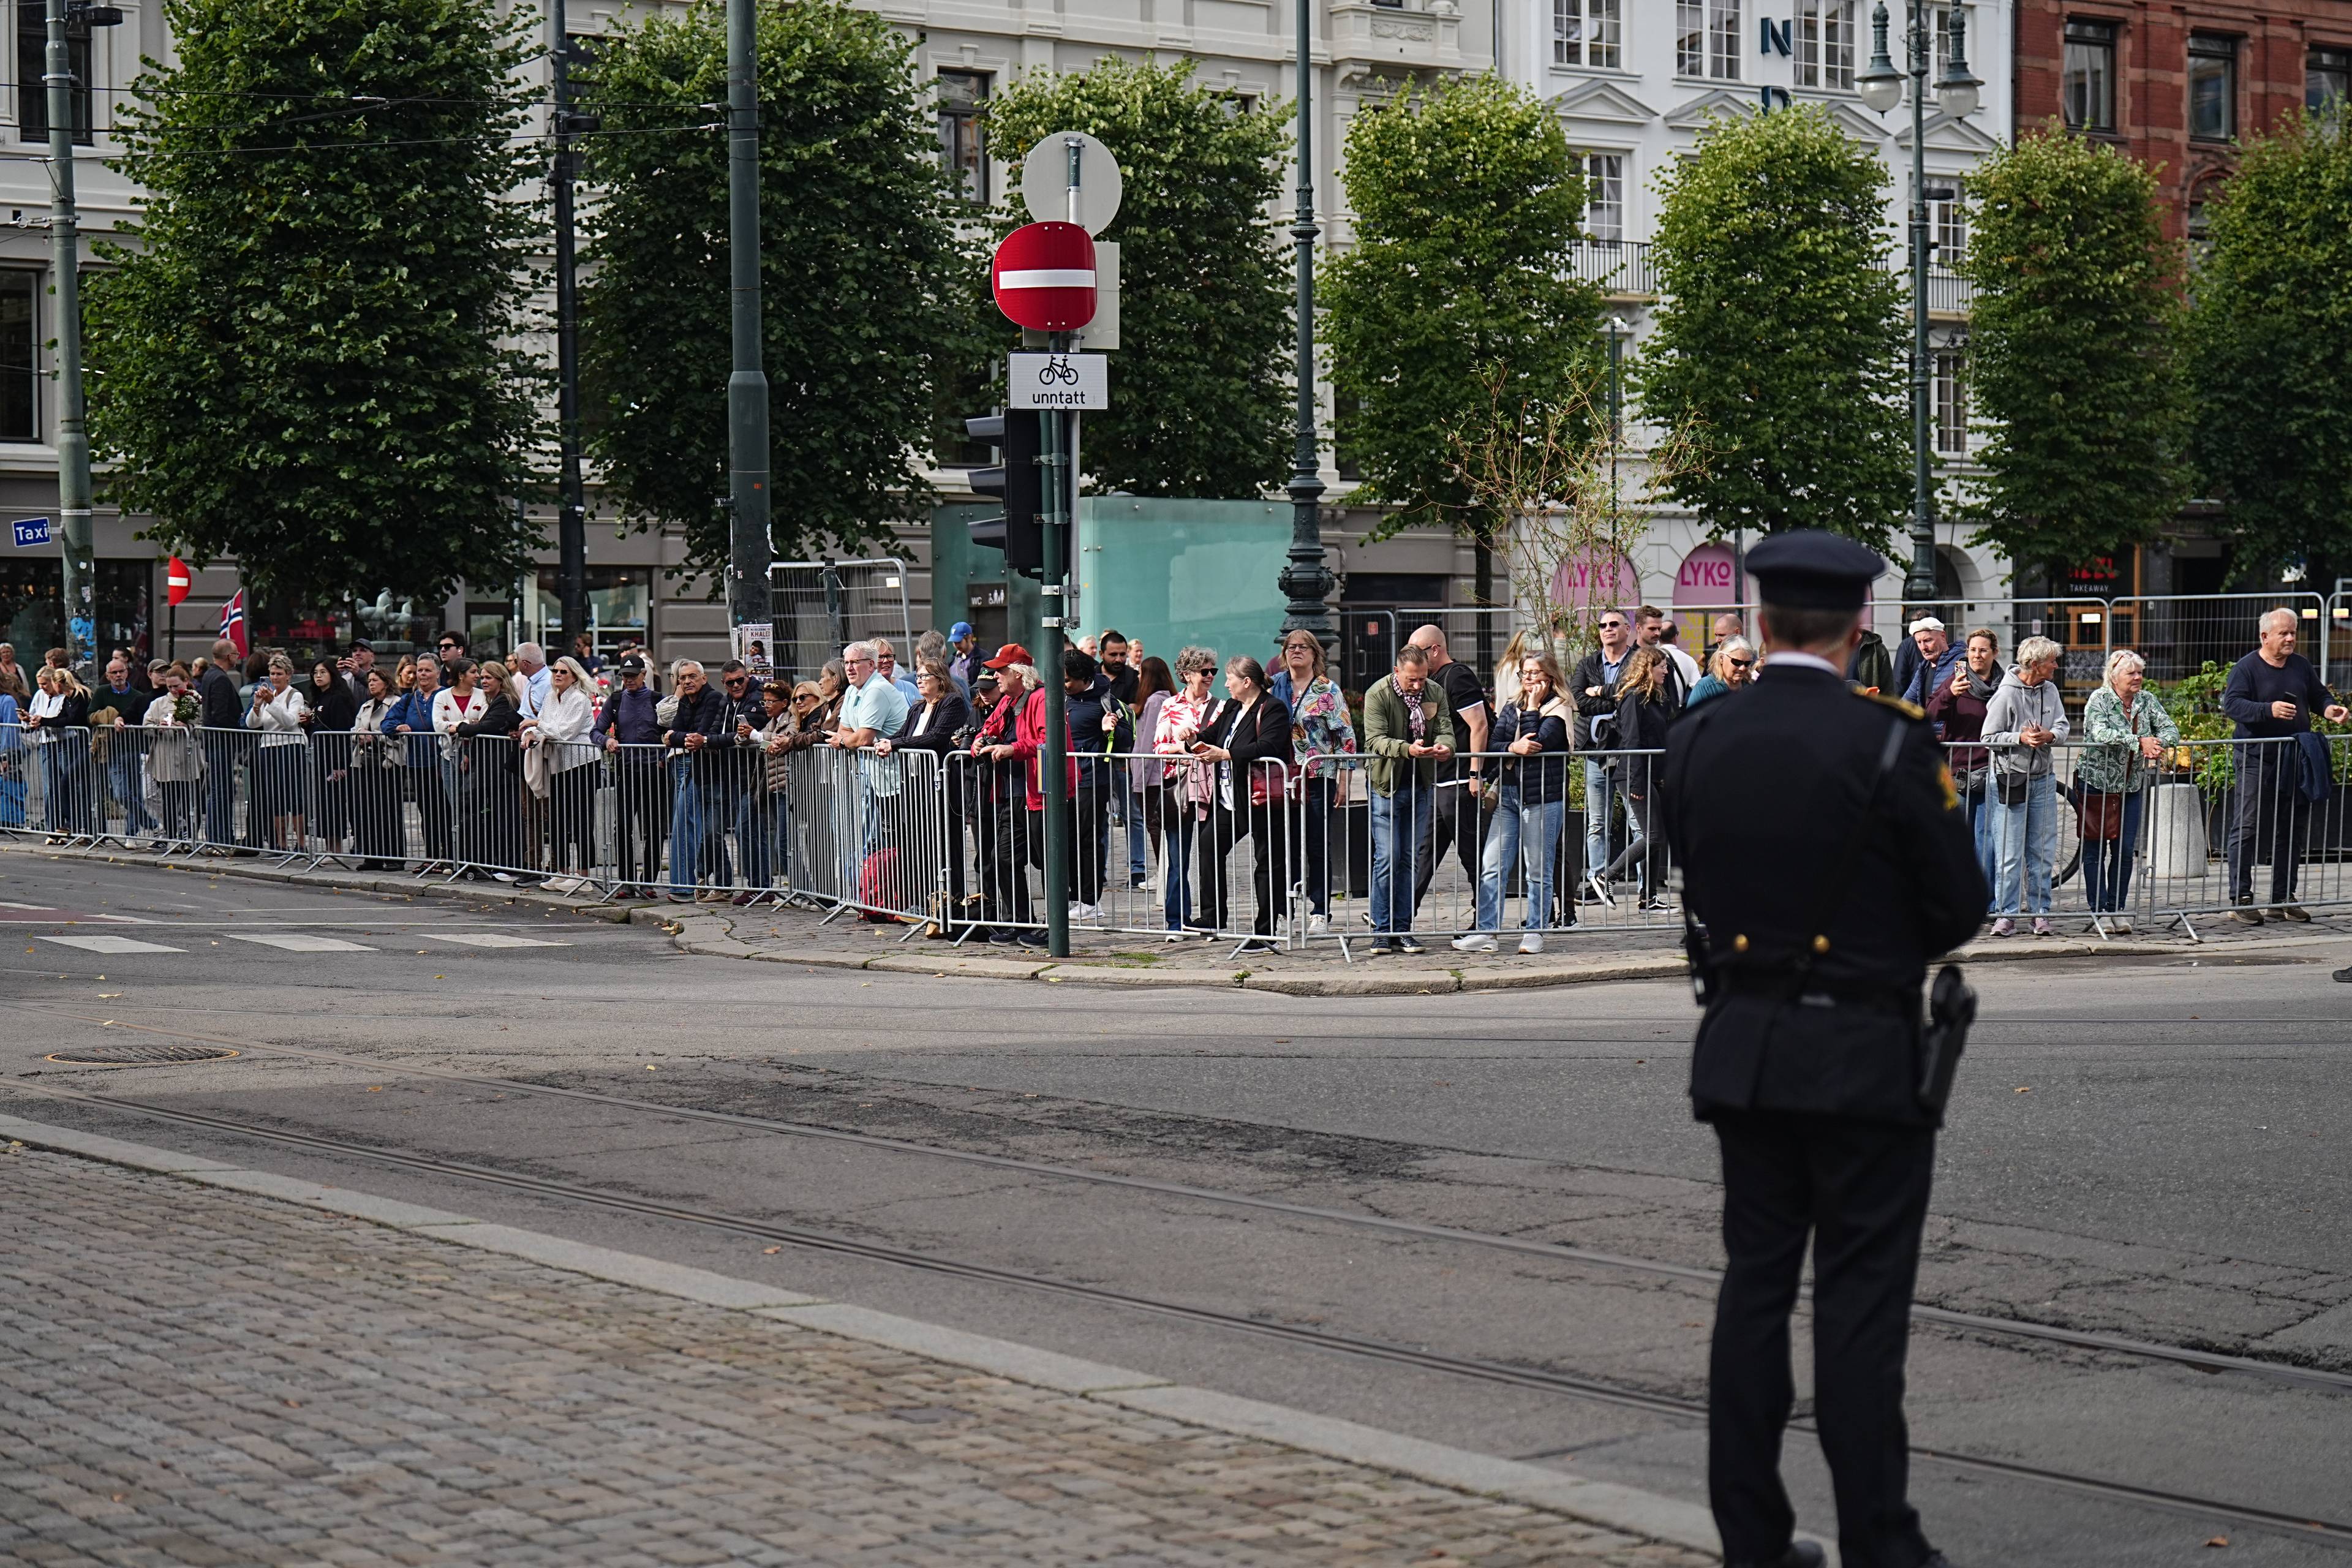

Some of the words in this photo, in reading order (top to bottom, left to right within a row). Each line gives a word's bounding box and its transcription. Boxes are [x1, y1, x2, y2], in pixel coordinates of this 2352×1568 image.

[1033, 391, 1085, 404] unntatt
[15, 523, 48, 540] Taxi
[1681, 561, 1731, 586] LYKO
[2070, 583, 2109, 593] TAKEAWAY
[971, 597, 982, 605] WC
